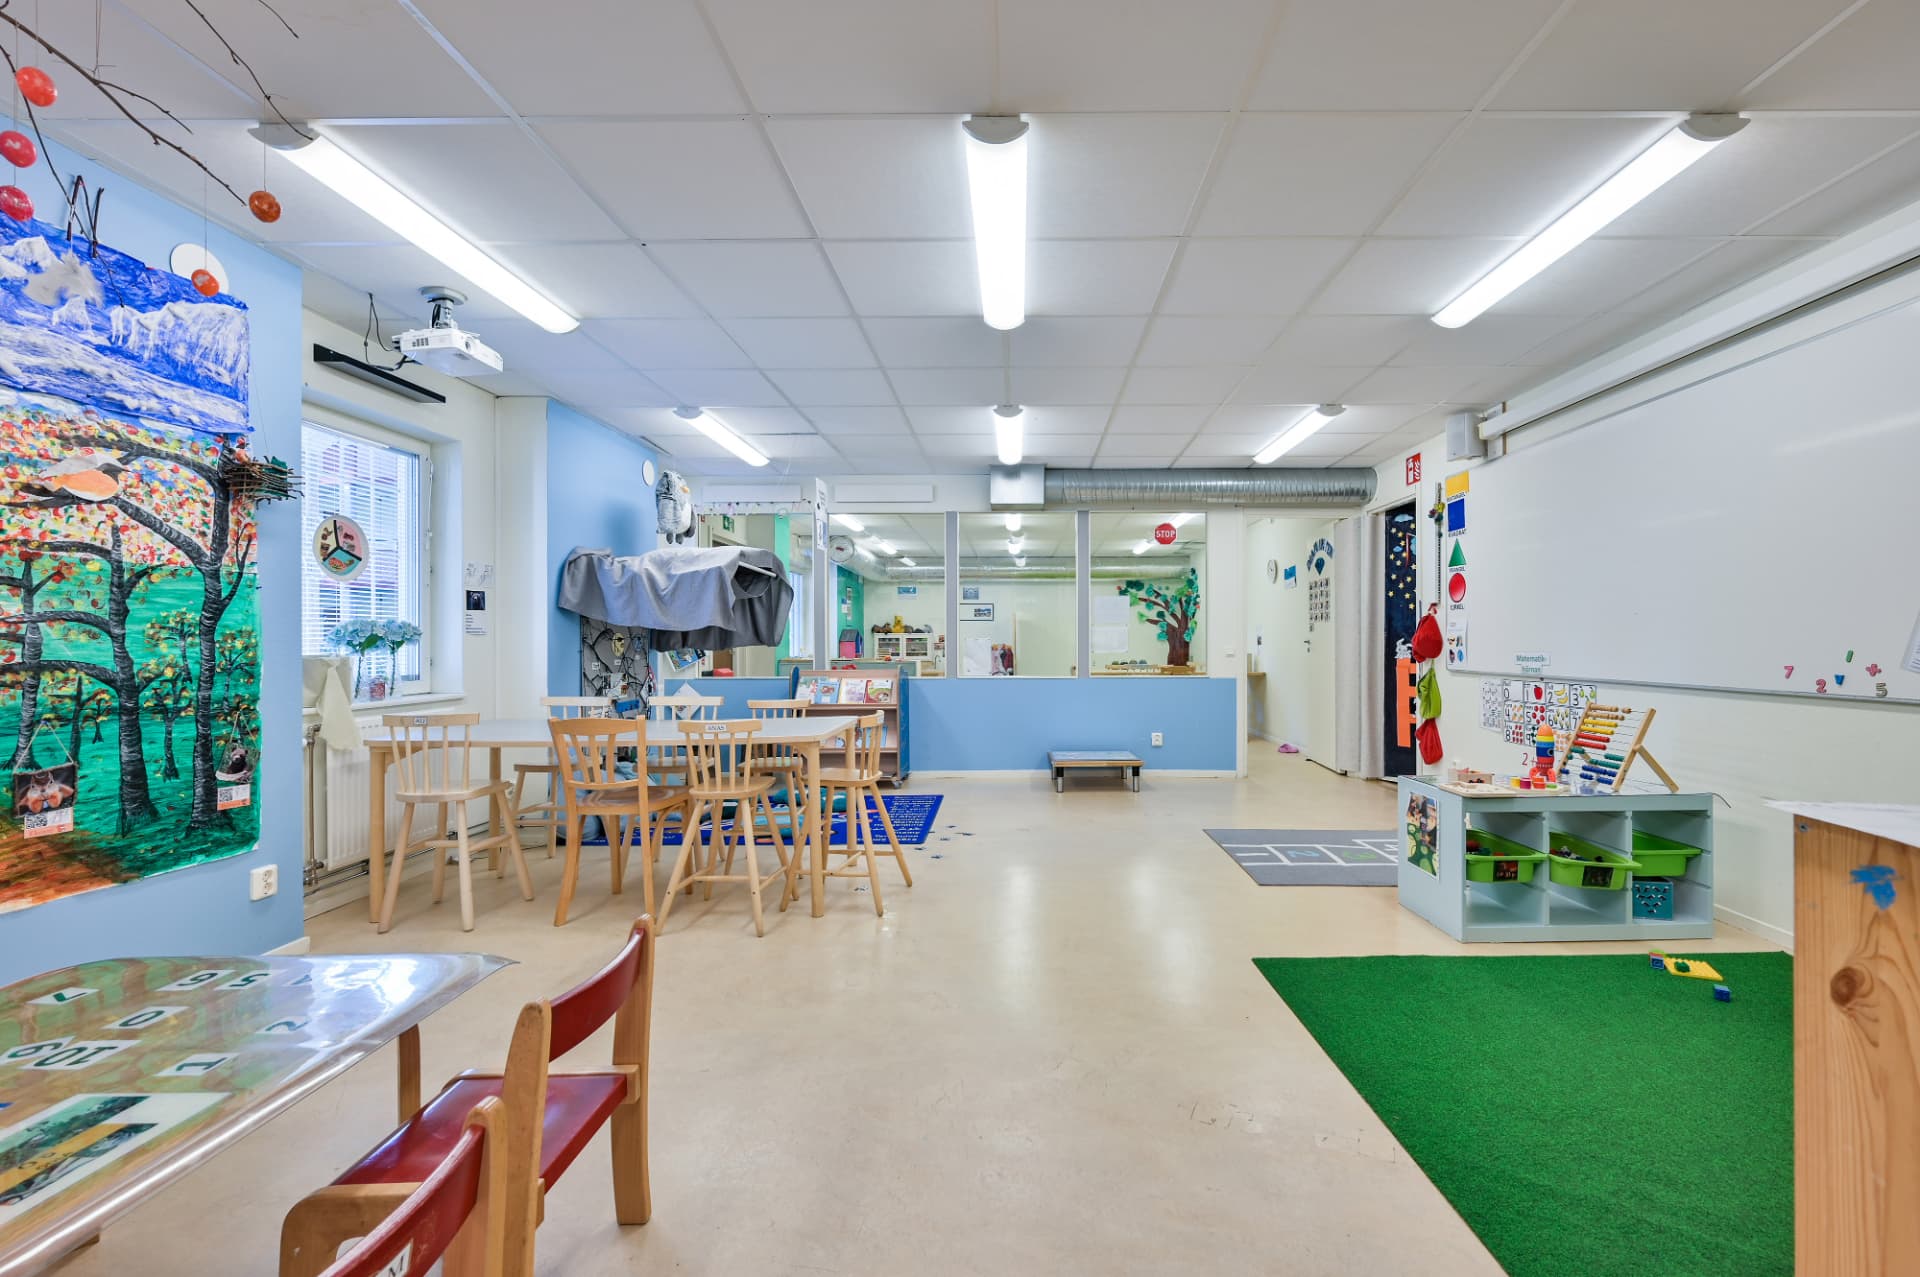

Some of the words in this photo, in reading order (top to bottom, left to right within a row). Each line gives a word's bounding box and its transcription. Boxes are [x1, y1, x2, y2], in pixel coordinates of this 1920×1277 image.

[1156, 530, 1176, 538] STOP
[1783, 665, 1794, 679] 7
[1816, 679, 1827, 694] 2
[1875, 683, 1888, 698] 5
[1503, 688, 1510, 699] 0
[1547, 691, 1554, 704] 2
[1572, 693, 1579, 706] 3
[1504, 708, 1510, 717] 4
[1525, 711, 1532, 723] 5
[1548, 714, 1554, 727] 6
[1572, 717, 1578, 729] 7
[1505, 729, 1511, 741] 8
[1525, 734, 1531, 745] 9
[1521, 752, 1528, 766] 2
[53, 990, 86, 1003] 7
[118, 1010, 165, 1028] 0
[33, 1046, 119, 1067] 10
